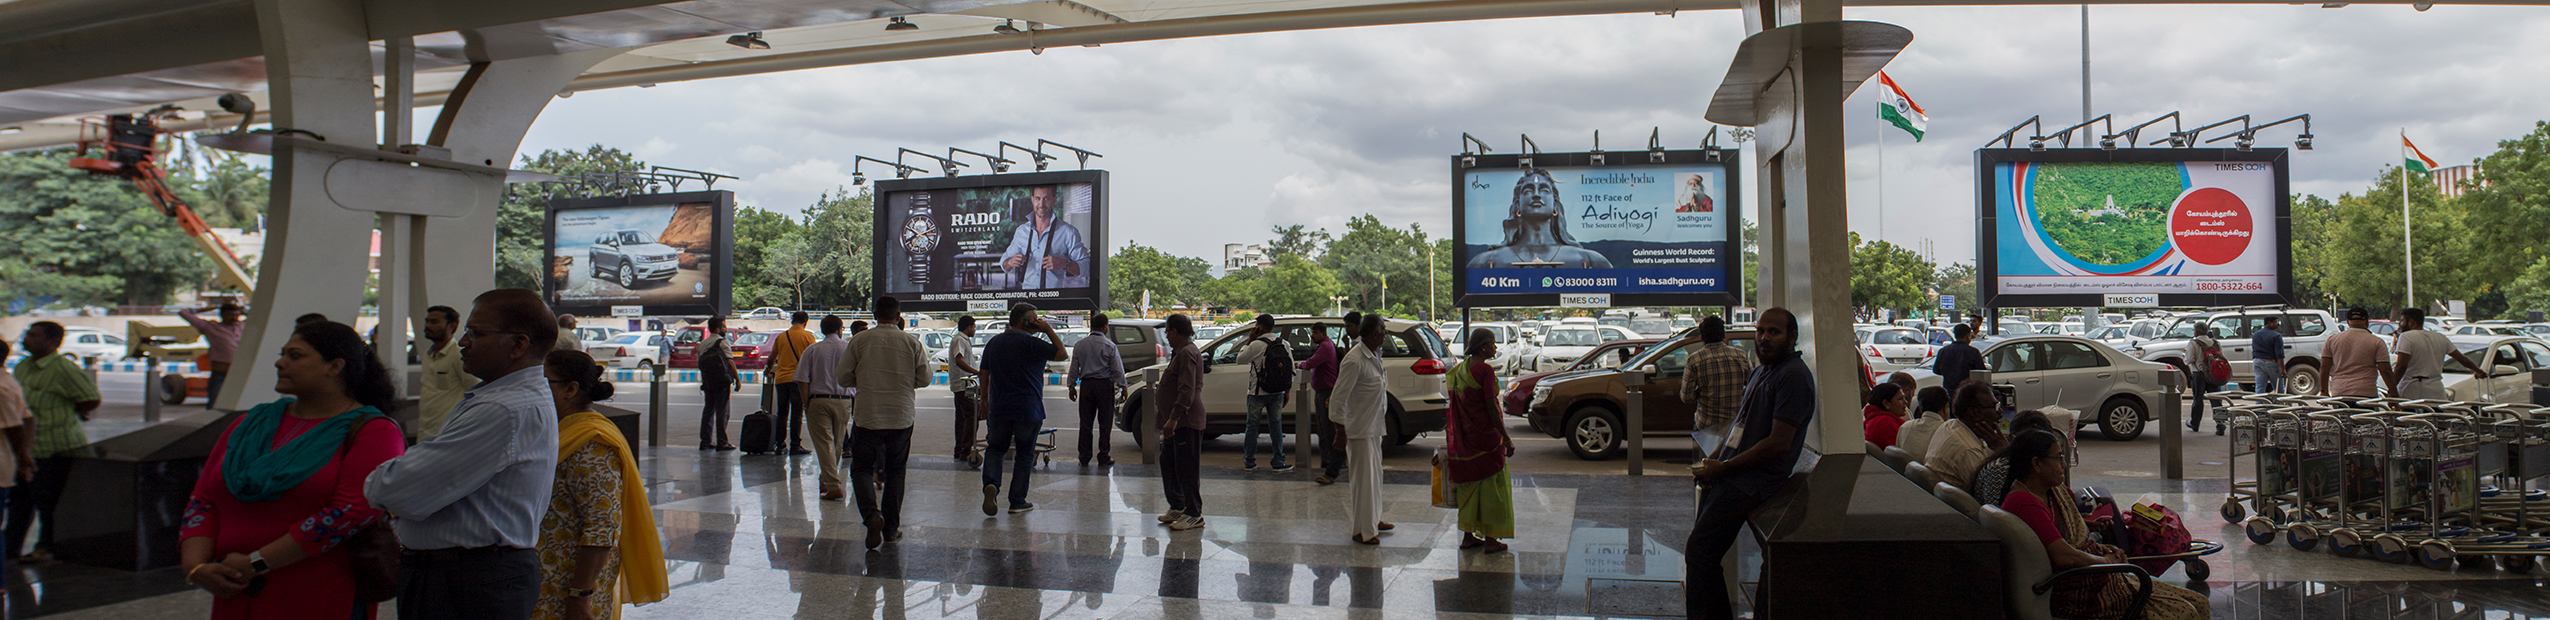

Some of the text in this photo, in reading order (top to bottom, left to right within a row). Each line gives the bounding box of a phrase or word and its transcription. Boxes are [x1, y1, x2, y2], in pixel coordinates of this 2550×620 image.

[2215, 163, 2244, 171] TIMES
[1581, 173, 1630, 184] Incredible
[1581, 193, 1633, 202] 112 ft Face of
[951, 212, 1000, 226] RADO
[1581, 204, 1658, 235] Adiyogi
[1677, 215, 1712, 223] Sadhguru
[1481, 277, 1520, 287] 40 Km
[1566, 277, 1617, 287] 83000 83111
[1638, 277, 1715, 287] isha.sadhguru.org
[2196, 282, 2263, 291] 1800-5322-664
